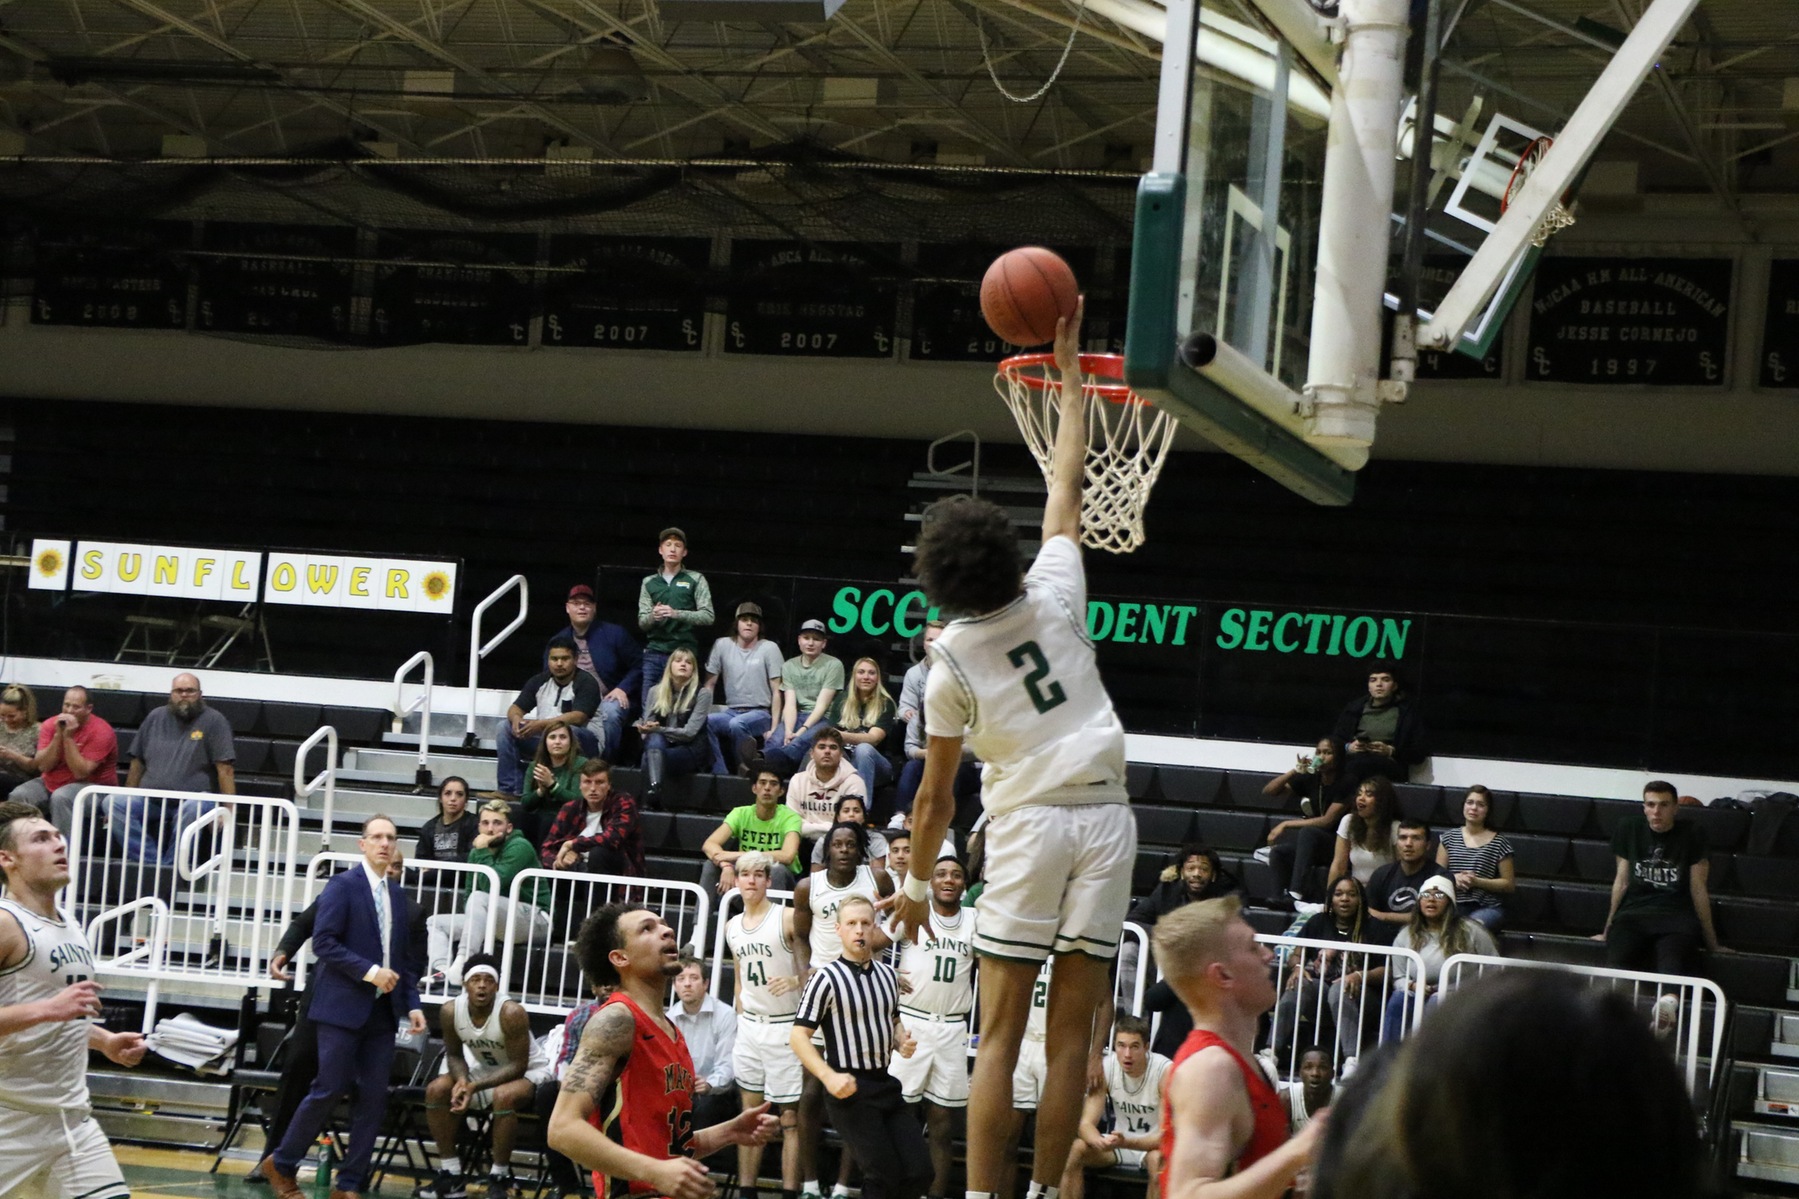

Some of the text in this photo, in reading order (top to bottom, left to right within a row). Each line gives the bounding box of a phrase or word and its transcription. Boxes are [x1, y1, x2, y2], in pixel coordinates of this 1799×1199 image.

[1534, 278, 1582, 315] NJCAA
[1581, 300, 1677, 316] BASEBALL
[593, 323, 649, 342] 2007
[780, 332, 839, 350] 2007
[1557, 325, 1698, 342] JESSE CORNEJO
[1591, 358, 1657, 376] 1997
[81, 550, 410, 598] SUNFLOWER
[828, 586, 1412, 660] SCC DENT SECTION
[1006, 640, 1067, 714] 2
[741, 829, 780, 845] EVENT
[1635, 862, 1678, 882] SAINTS
[924, 937, 969, 957] SAINTS
[747, 960, 768, 987] 41
[933, 955, 957, 984] 10
[461, 1039, 505, 1050] AINTS
[481, 1051, 499, 1067] 5
[667, 1105, 696, 1159] 12
[1127, 1116, 1151, 1133] 14
